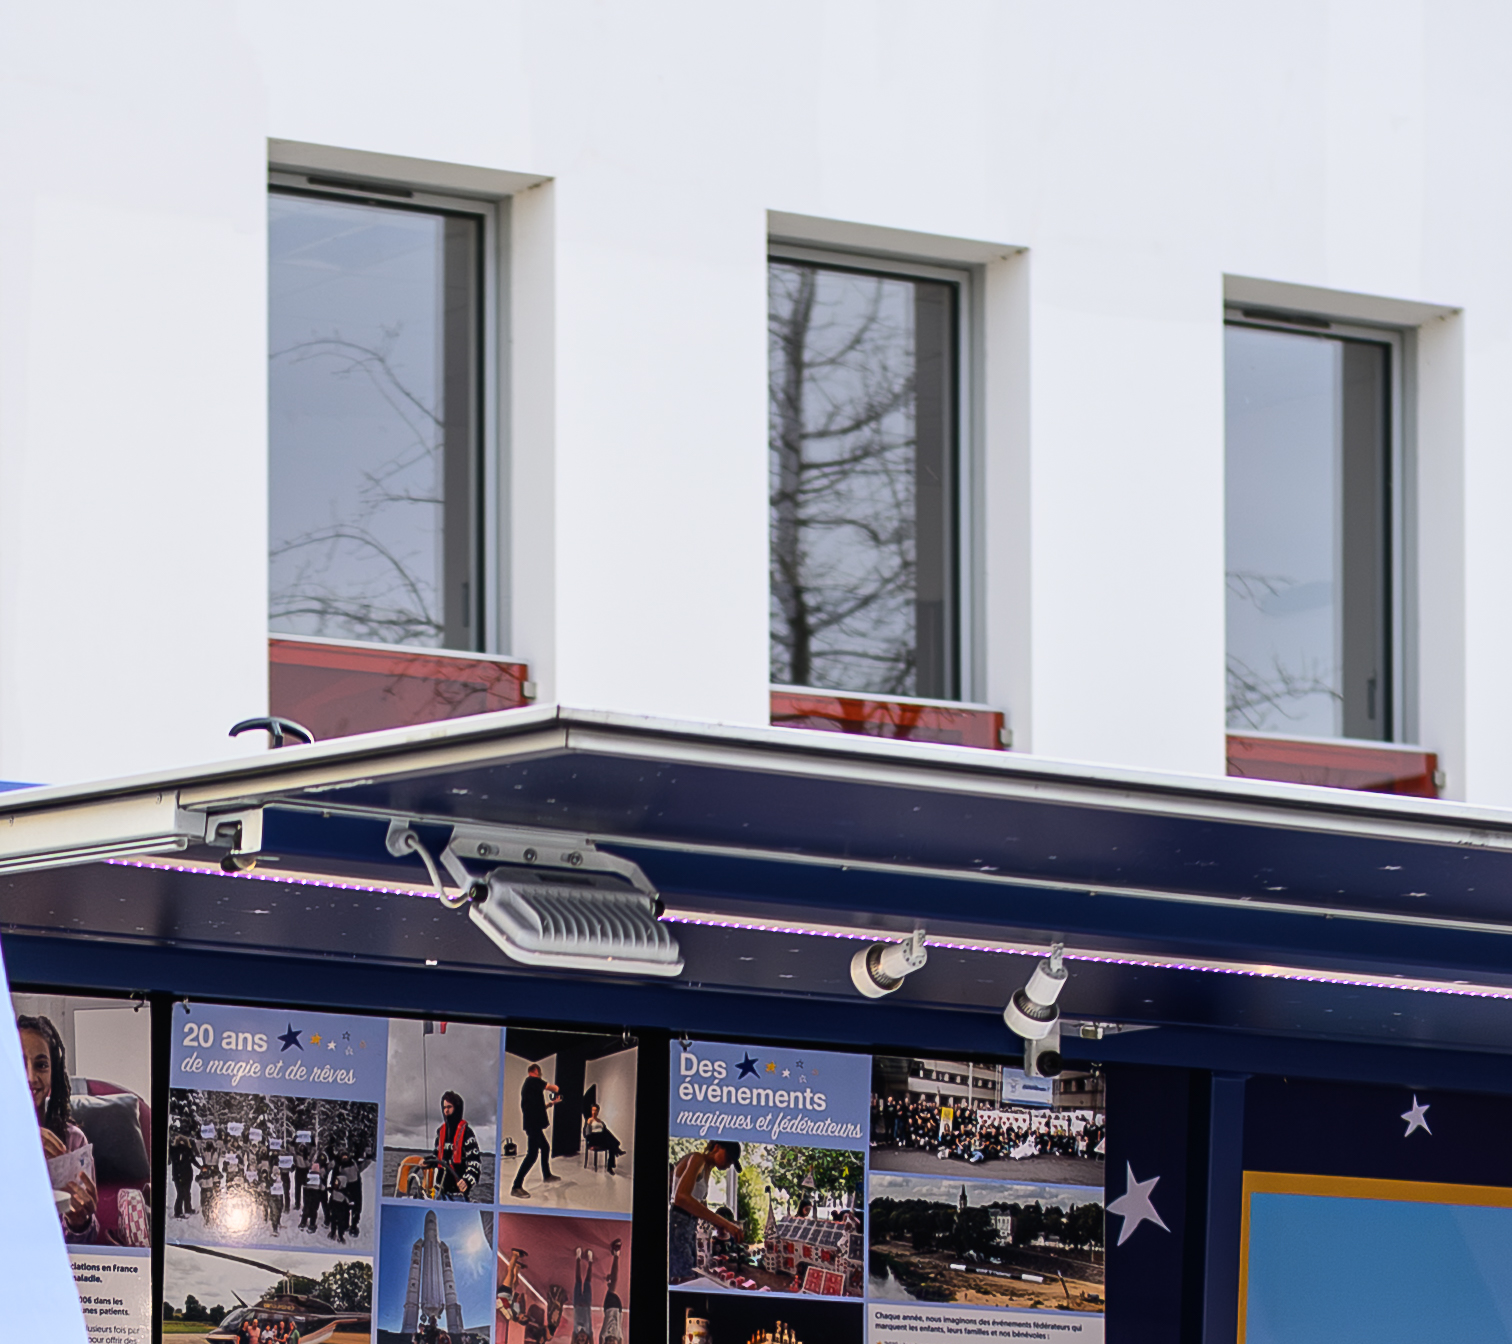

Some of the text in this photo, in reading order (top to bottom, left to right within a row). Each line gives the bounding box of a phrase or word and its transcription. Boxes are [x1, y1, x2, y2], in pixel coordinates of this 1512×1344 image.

[183, 1023, 267, 1052] 20 ans
[181, 1052, 356, 1086] de magie et de rêves
[681, 1052, 726, 1078] Des
[679, 1081, 826, 1110] événements
[677, 1111, 863, 1139] magiques et fédérateurs
[112, 1263, 139, 1274] France
